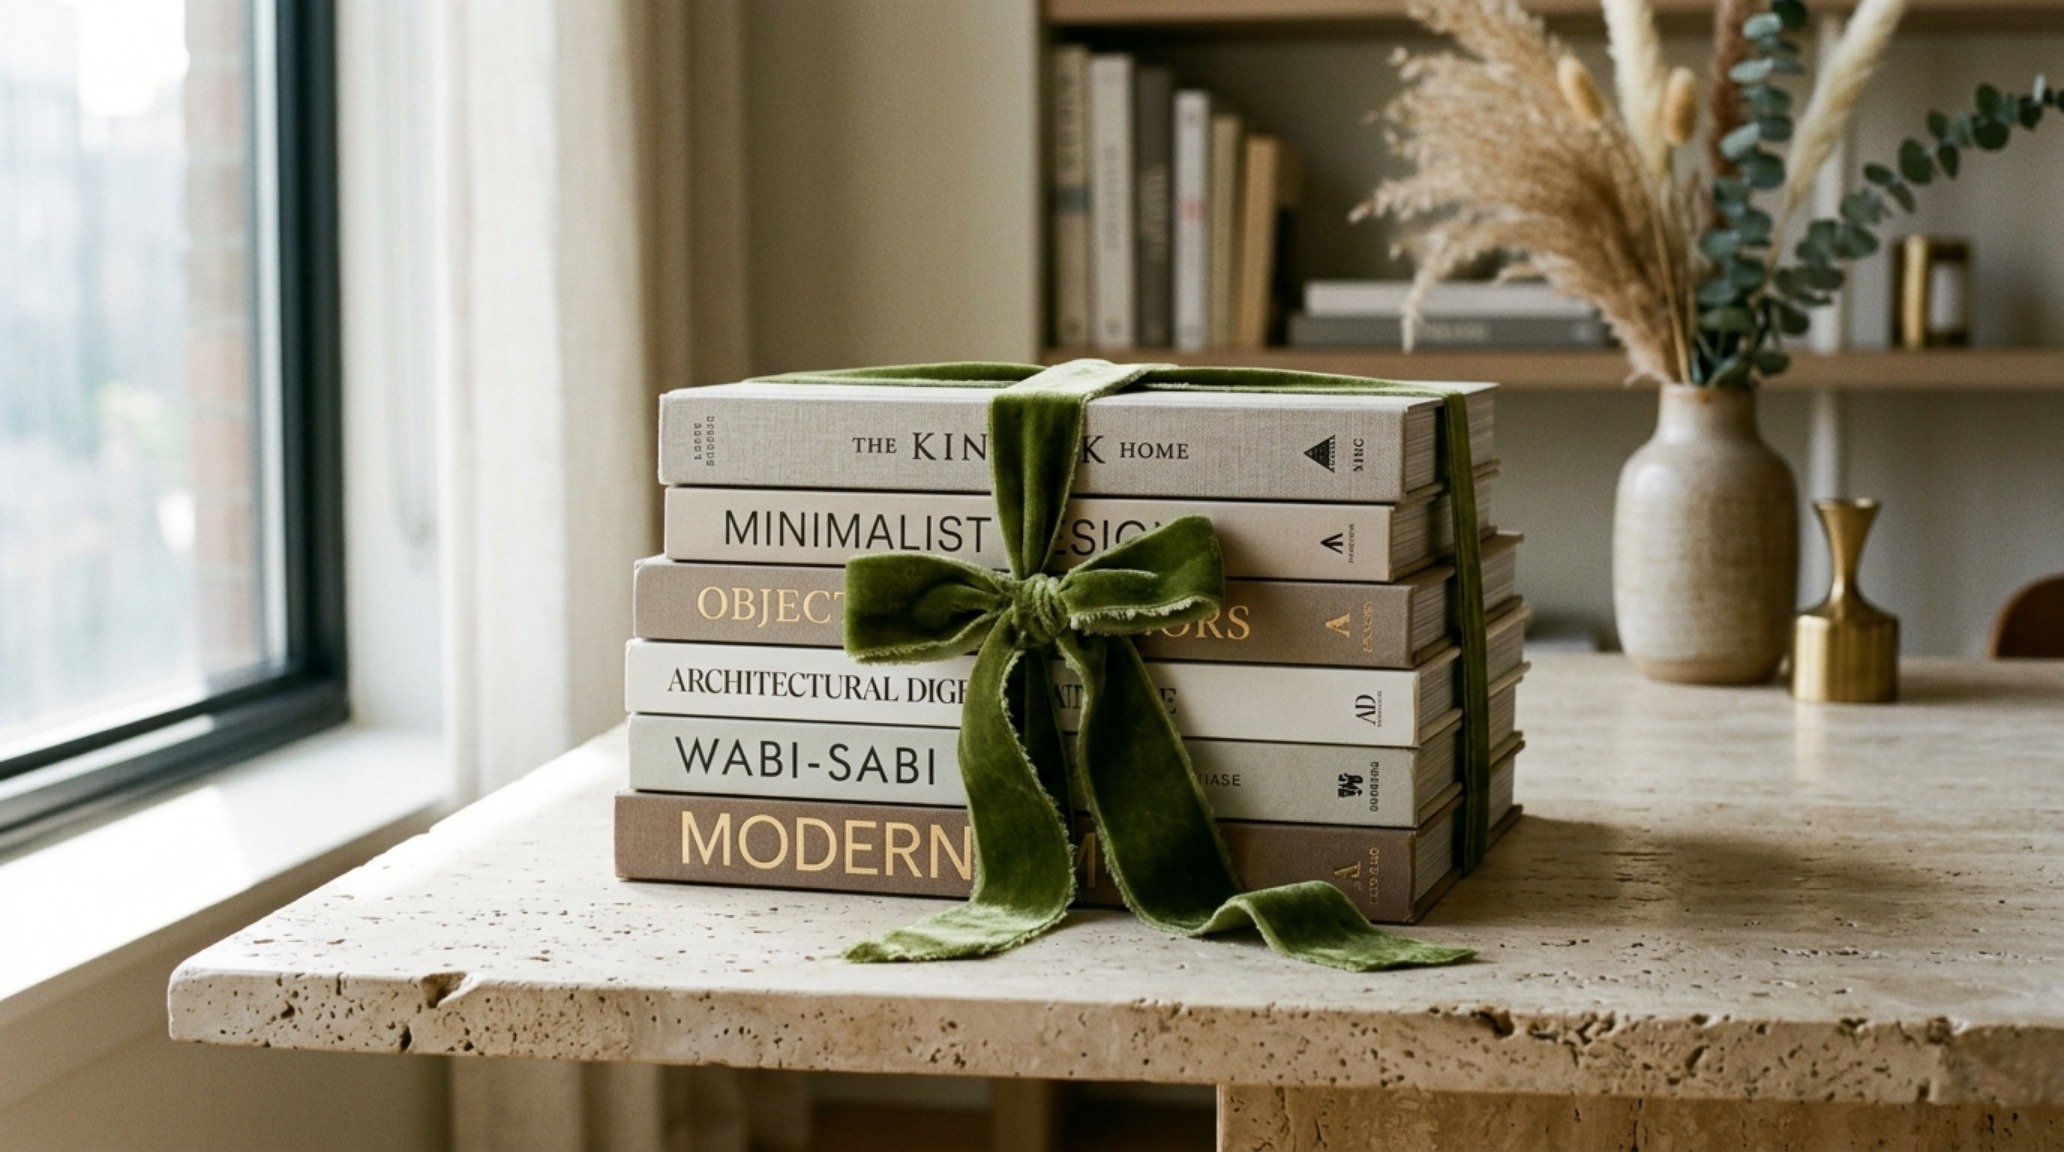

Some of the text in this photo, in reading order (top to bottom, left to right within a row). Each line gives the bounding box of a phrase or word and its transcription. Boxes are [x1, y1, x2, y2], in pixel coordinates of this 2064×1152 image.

[853, 437, 897, 454] THE
[1119, 442, 1189, 460] HOME
[724, 510, 992, 553] MINIMALIST
[697, 586, 845, 628] OBJEC
[668, 667, 899, 702] ARCHITECTURAL
[1355, 694, 1376, 725] AD
[675, 737, 934, 785] WABI-SABI
[681, 811, 972, 879] MODERN
